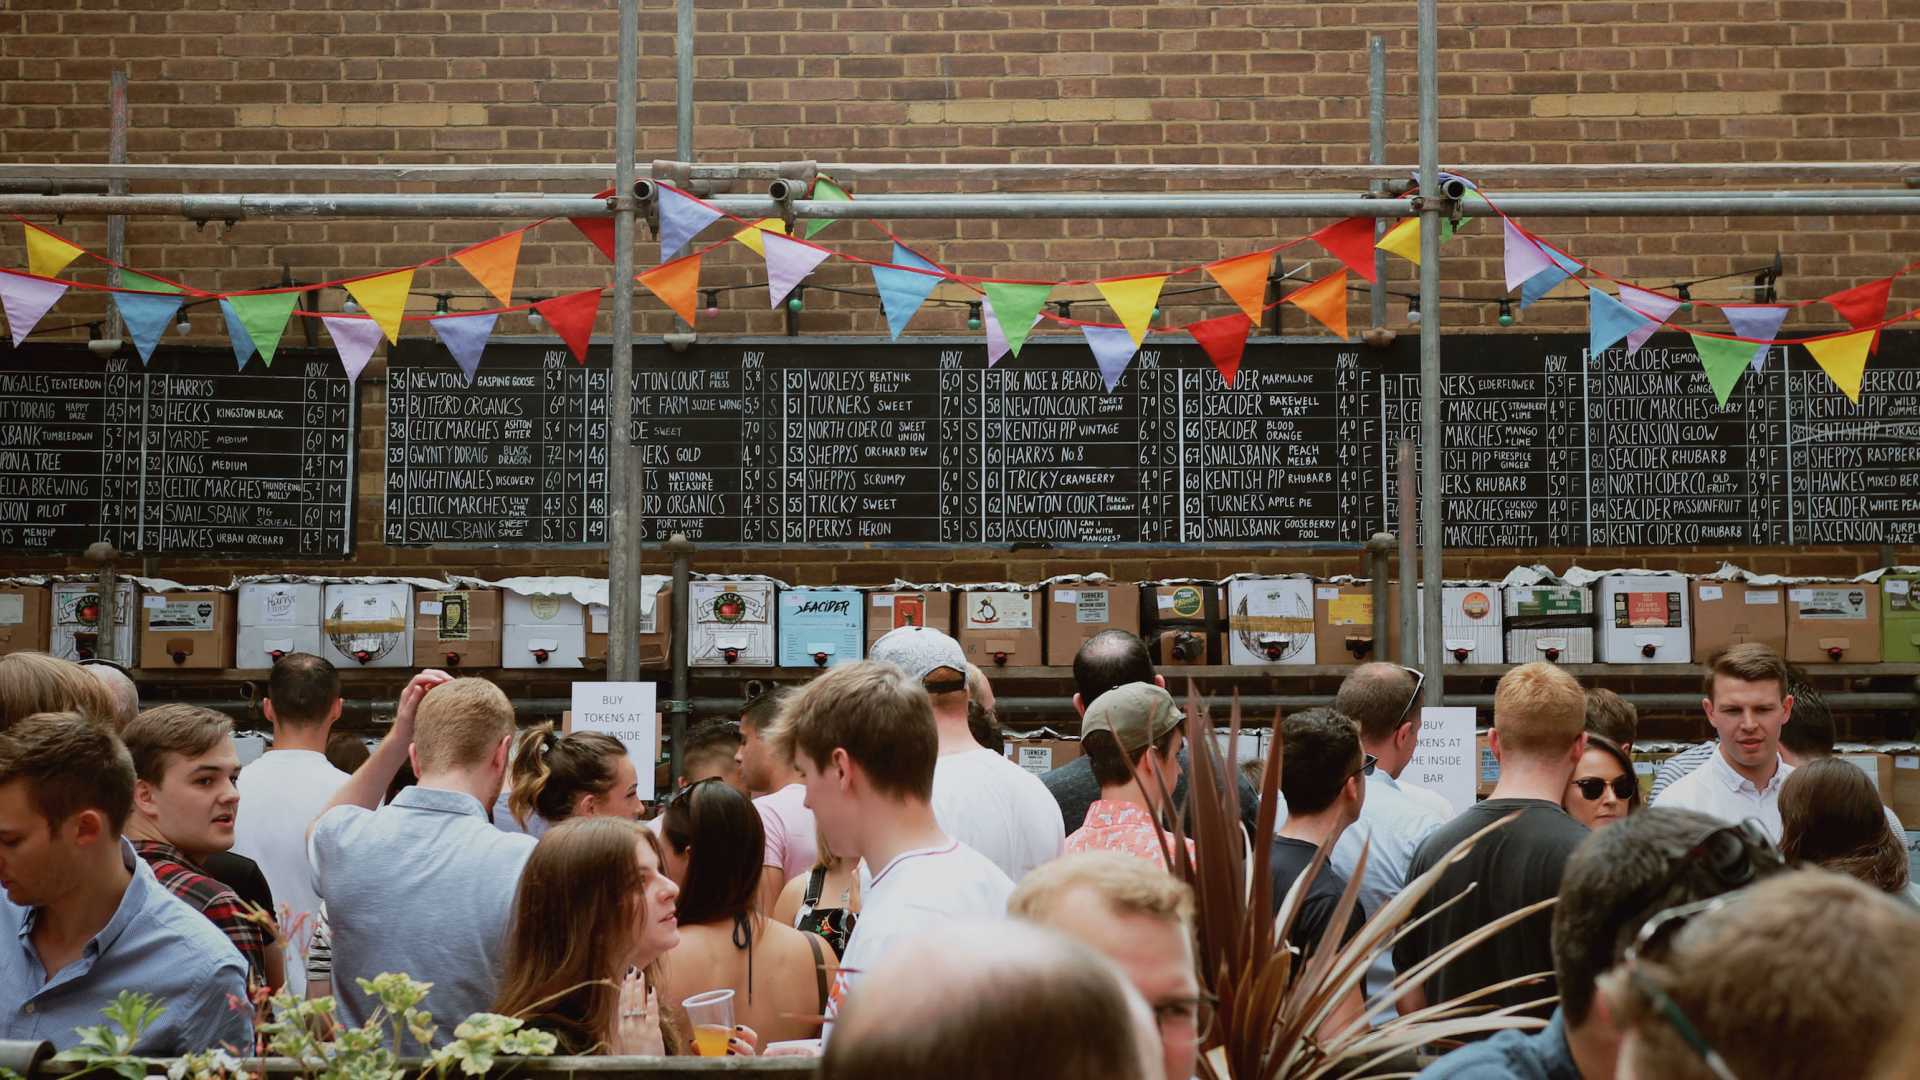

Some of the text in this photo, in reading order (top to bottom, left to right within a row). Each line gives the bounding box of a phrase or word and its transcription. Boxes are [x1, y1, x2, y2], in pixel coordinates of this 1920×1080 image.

[1608, 349, 1670, 371] SEACIDER
[170, 380, 214, 396] HARRYS
[391, 374, 509, 389] 36 GASPING
[589, 370, 705, 390] 43 COURT
[788, 371, 911, 393] 50 WORLEYS BEATNIK BILLY
[987, 371, 1048, 391] 57 BIG NOSE
[1262, 375, 1313, 384] MARMALADE
[1479, 379, 1535, 390] ELDERFLOWER
[1608, 375, 1683, 395] SNAILSBANK
[168, 402, 255, 423] HECKS KINGSTON
[390, 397, 523, 416] 37 ORGANICS
[659, 398, 689, 414] FARM
[788, 396, 913, 415] 51 TURNERS SWEET
[1205, 395, 1319, 416] SEACIDER BAKEWELL TART
[1448, 401, 1507, 421] MARCHES
[1589, 398, 1709, 420] 80 CELTIC MARCHES
[390, 420, 532, 439] 38 ASHTON BITTER
[654, 427, 683, 436] SWEET
[788, 421, 926, 441] 52 NORTH CIDER CO SWEET UNION
[988, 421, 1119, 440] 59 KENTISH PIP VINTAGE
[1205, 420, 1302, 440] SEACIDER BLOOD ORANGE
[1445, 426, 1537, 446] MARCHES MANGO
[1609, 423, 1718, 444] ASCENSION GLOW
[168, 430, 211, 449] YARDE
[35, 453, 61, 470] TREE
[167, 455, 247, 474] KINGS MEDIUM
[389, 449, 531, 464] 39 DRAGON
[677, 449, 700, 461] GOLD
[788, 445, 928, 465] 53 SHEPPYS ORCHARD DEW
[988, 446, 1054, 464] 60 HARRYS
[1204, 445, 1319, 466] SNAILSBANK PEACH MELBA
[1472, 452, 1529, 470] PIP GINGER
[1609, 448, 1727, 469] SEACIDER RHUBARB
[1811, 447, 1862, 467] SHEPPYS
[32, 480, 88, 496] BREWING
[165, 479, 261, 498] CELTIC MARCHES
[389, 470, 535, 490] 40 NIGHTINGALES DISCOVERY
[669, 472, 713, 491] NATIONAL TREASURE
[787, 470, 906, 491] 54 SHEPPYS SCRUMPY
[1008, 470, 1115, 489] TRICKY CRANBERRY
[1205, 469, 1331, 490] KENTISH PIP RHUBARB
[1476, 477, 1526, 492] RHUBARB
[1610, 473, 1738, 494] NORTH OLD FRUITY
[1812, 472, 1896, 492] HAWKES MIXED
[37, 503, 67, 517] PILOT
[257, 507, 272, 516] PIG
[389, 496, 507, 515] 41 CELTIC MARCHES
[667, 495, 725, 514] ORGANICS
[788, 495, 897, 513] 55 TRICKY SWEET
[1007, 495, 1106, 513] NEWTON COURT
[1208, 495, 1312, 512] TURNERS APPLE PIE
[1449, 500, 1537, 521] MARCHES CUCKOO PENNY
[1592, 499, 1742, 520] 84 SEACIDER PASSIONFRUIT
[1812, 497, 1899, 518] SEACIDER WHITE
[23, 528, 56, 536] MENDIP
[388, 524, 402, 539] 42
[657, 519, 703, 528] PORT WINE
[787, 519, 891, 538] 56 PERRYS HERON
[1007, 518, 1077, 539] ASCENSION
[1207, 518, 1335, 538] SNAILSBANK GOOSEBERRY FOOL
[1814, 522, 1883, 541] ASCENSION
[163, 529, 243, 548] HAWKES URBAN
[1445, 526, 1495, 546] MARCHES
[1593, 524, 1742, 544] 85 KENT CIDER RHUBARB
[603, 696, 623, 704] BUY
[584, 713, 641, 722] TOKENS AT
[1424, 721, 1444, 729] BUY
[1416, 738, 1460, 747] KENS AT
[1411, 756, 1461, 765] HE INSIDE
[1424, 774, 1443, 782] BAR
